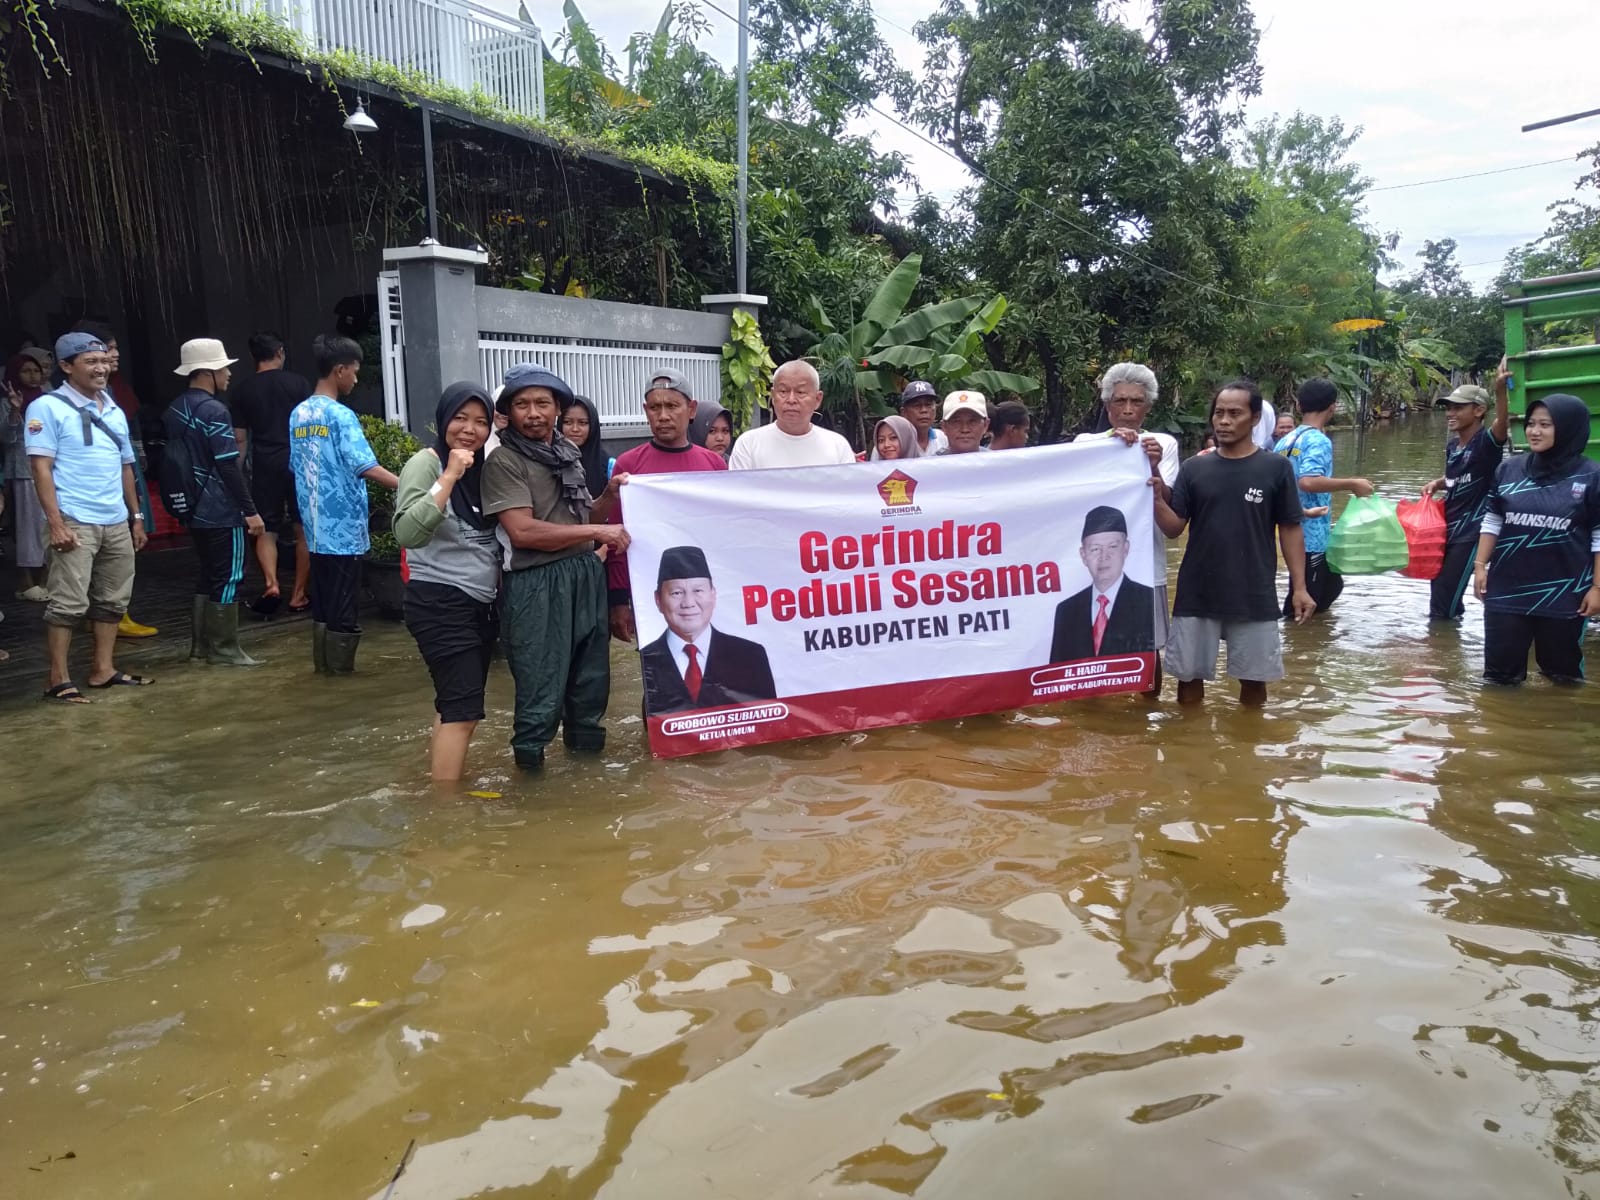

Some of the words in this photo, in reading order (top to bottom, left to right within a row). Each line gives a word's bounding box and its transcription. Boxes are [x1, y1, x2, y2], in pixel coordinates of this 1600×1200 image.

[880, 505, 922, 515] GERINDRA
[799, 519, 1002, 574] Gerindra
[742, 572, 882, 625] Peduli
[891, 560, 1062, 609] Sesama
[804, 615, 949, 652] KABUPATEN
[958, 608, 1010, 635] PATI
[1076, 663, 1108, 676] HARDI
[1032, 684, 1060, 696] KETUA
[1059, 682, 1077, 693] DPC
[1077, 677, 1123, 690] KABUPATEN
[1123, 675, 1142, 684] PATI
[670, 714, 726, 732] PROBOWO
[727, 706, 782, 723] SUBIANTO
[699, 730, 726, 741] KETUA
[726, 725, 756, 737] UMUM
